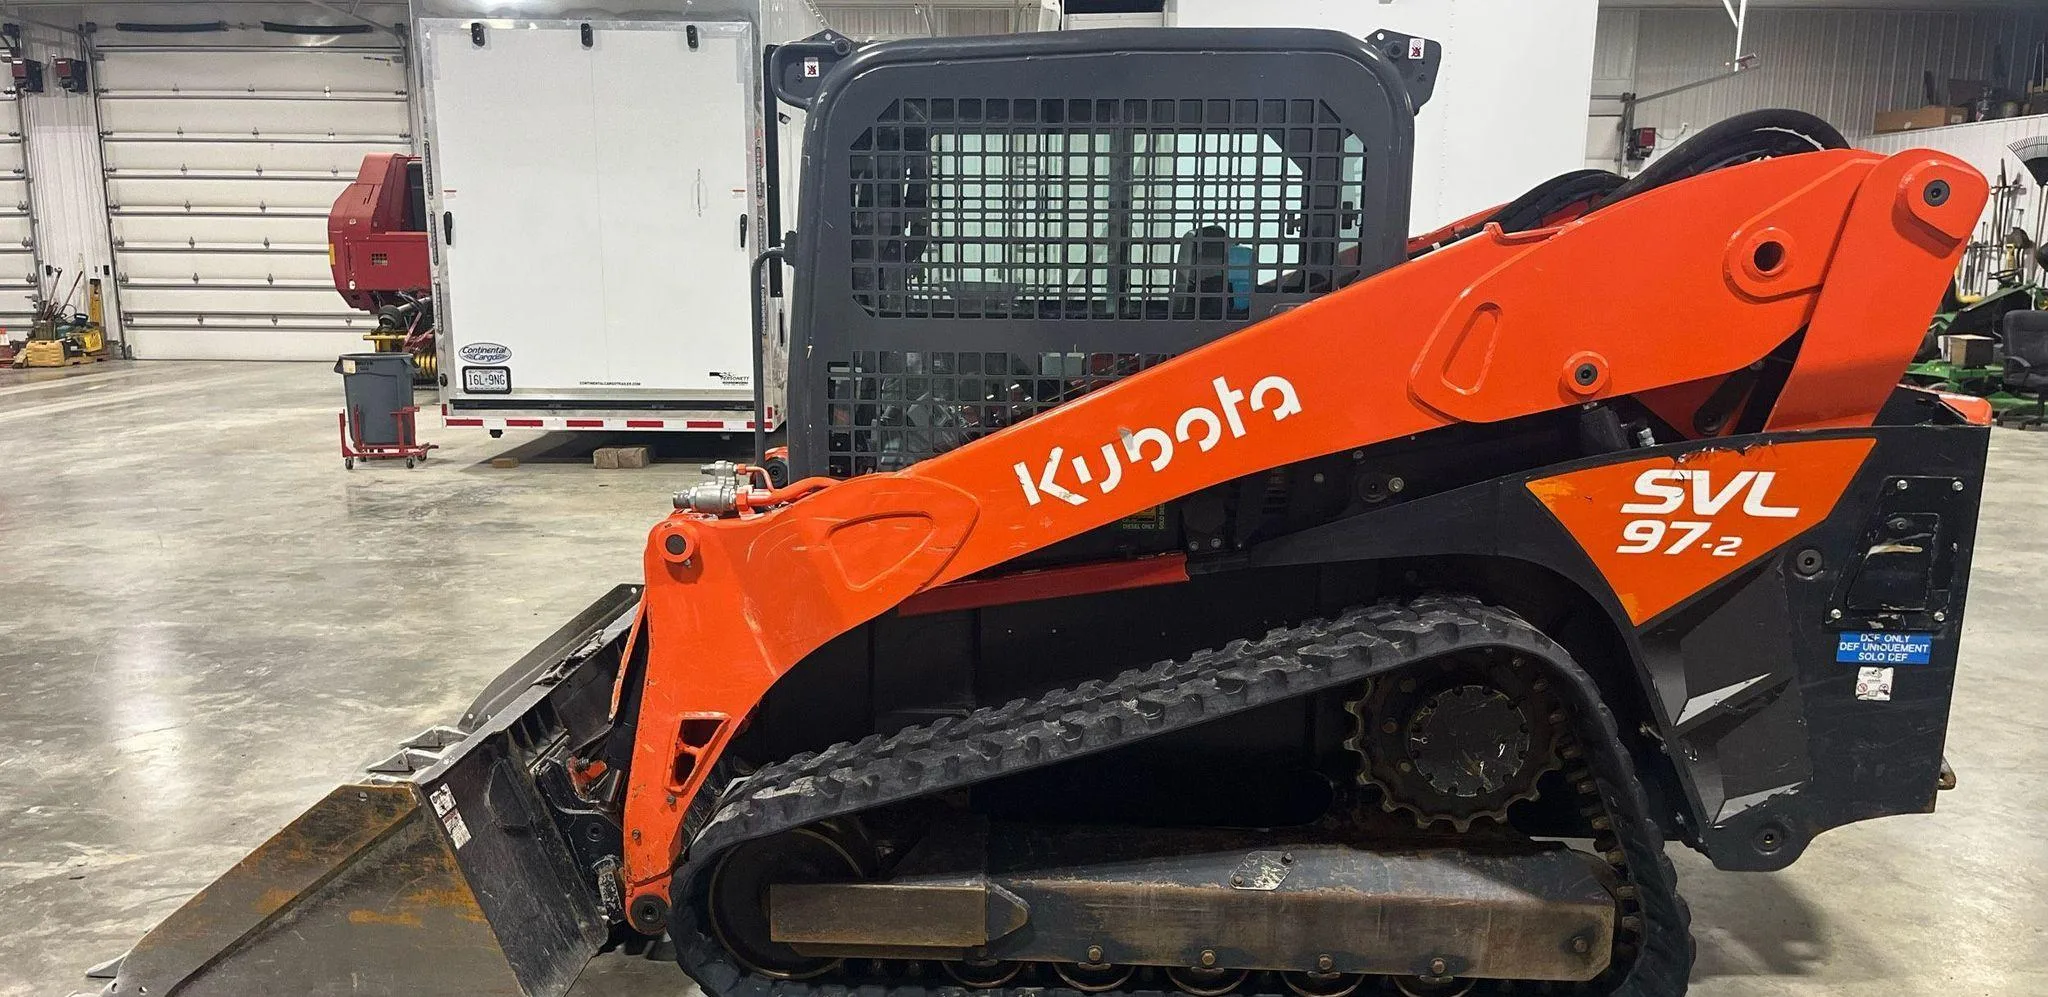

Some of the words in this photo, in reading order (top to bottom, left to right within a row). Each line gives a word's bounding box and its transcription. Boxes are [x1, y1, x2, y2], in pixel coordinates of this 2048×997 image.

[462, 346, 508, 354] Continental
[473, 354, 499, 362] Cargo
[1013, 376, 1302, 506] Kubota
[1620, 469, 1800, 517] SVL
[1616, 519, 1743, 556] 97-2
[1860, 633, 1880, 642] DEF
[1884, 634, 1911, 643] ONLY
[1839, 642, 1860, 651] DEF
[1862, 643, 1929, 653] UNIQUEMENT
[1858, 652, 1885, 661] SOLO
[1887, 653, 1908, 662] DEF
